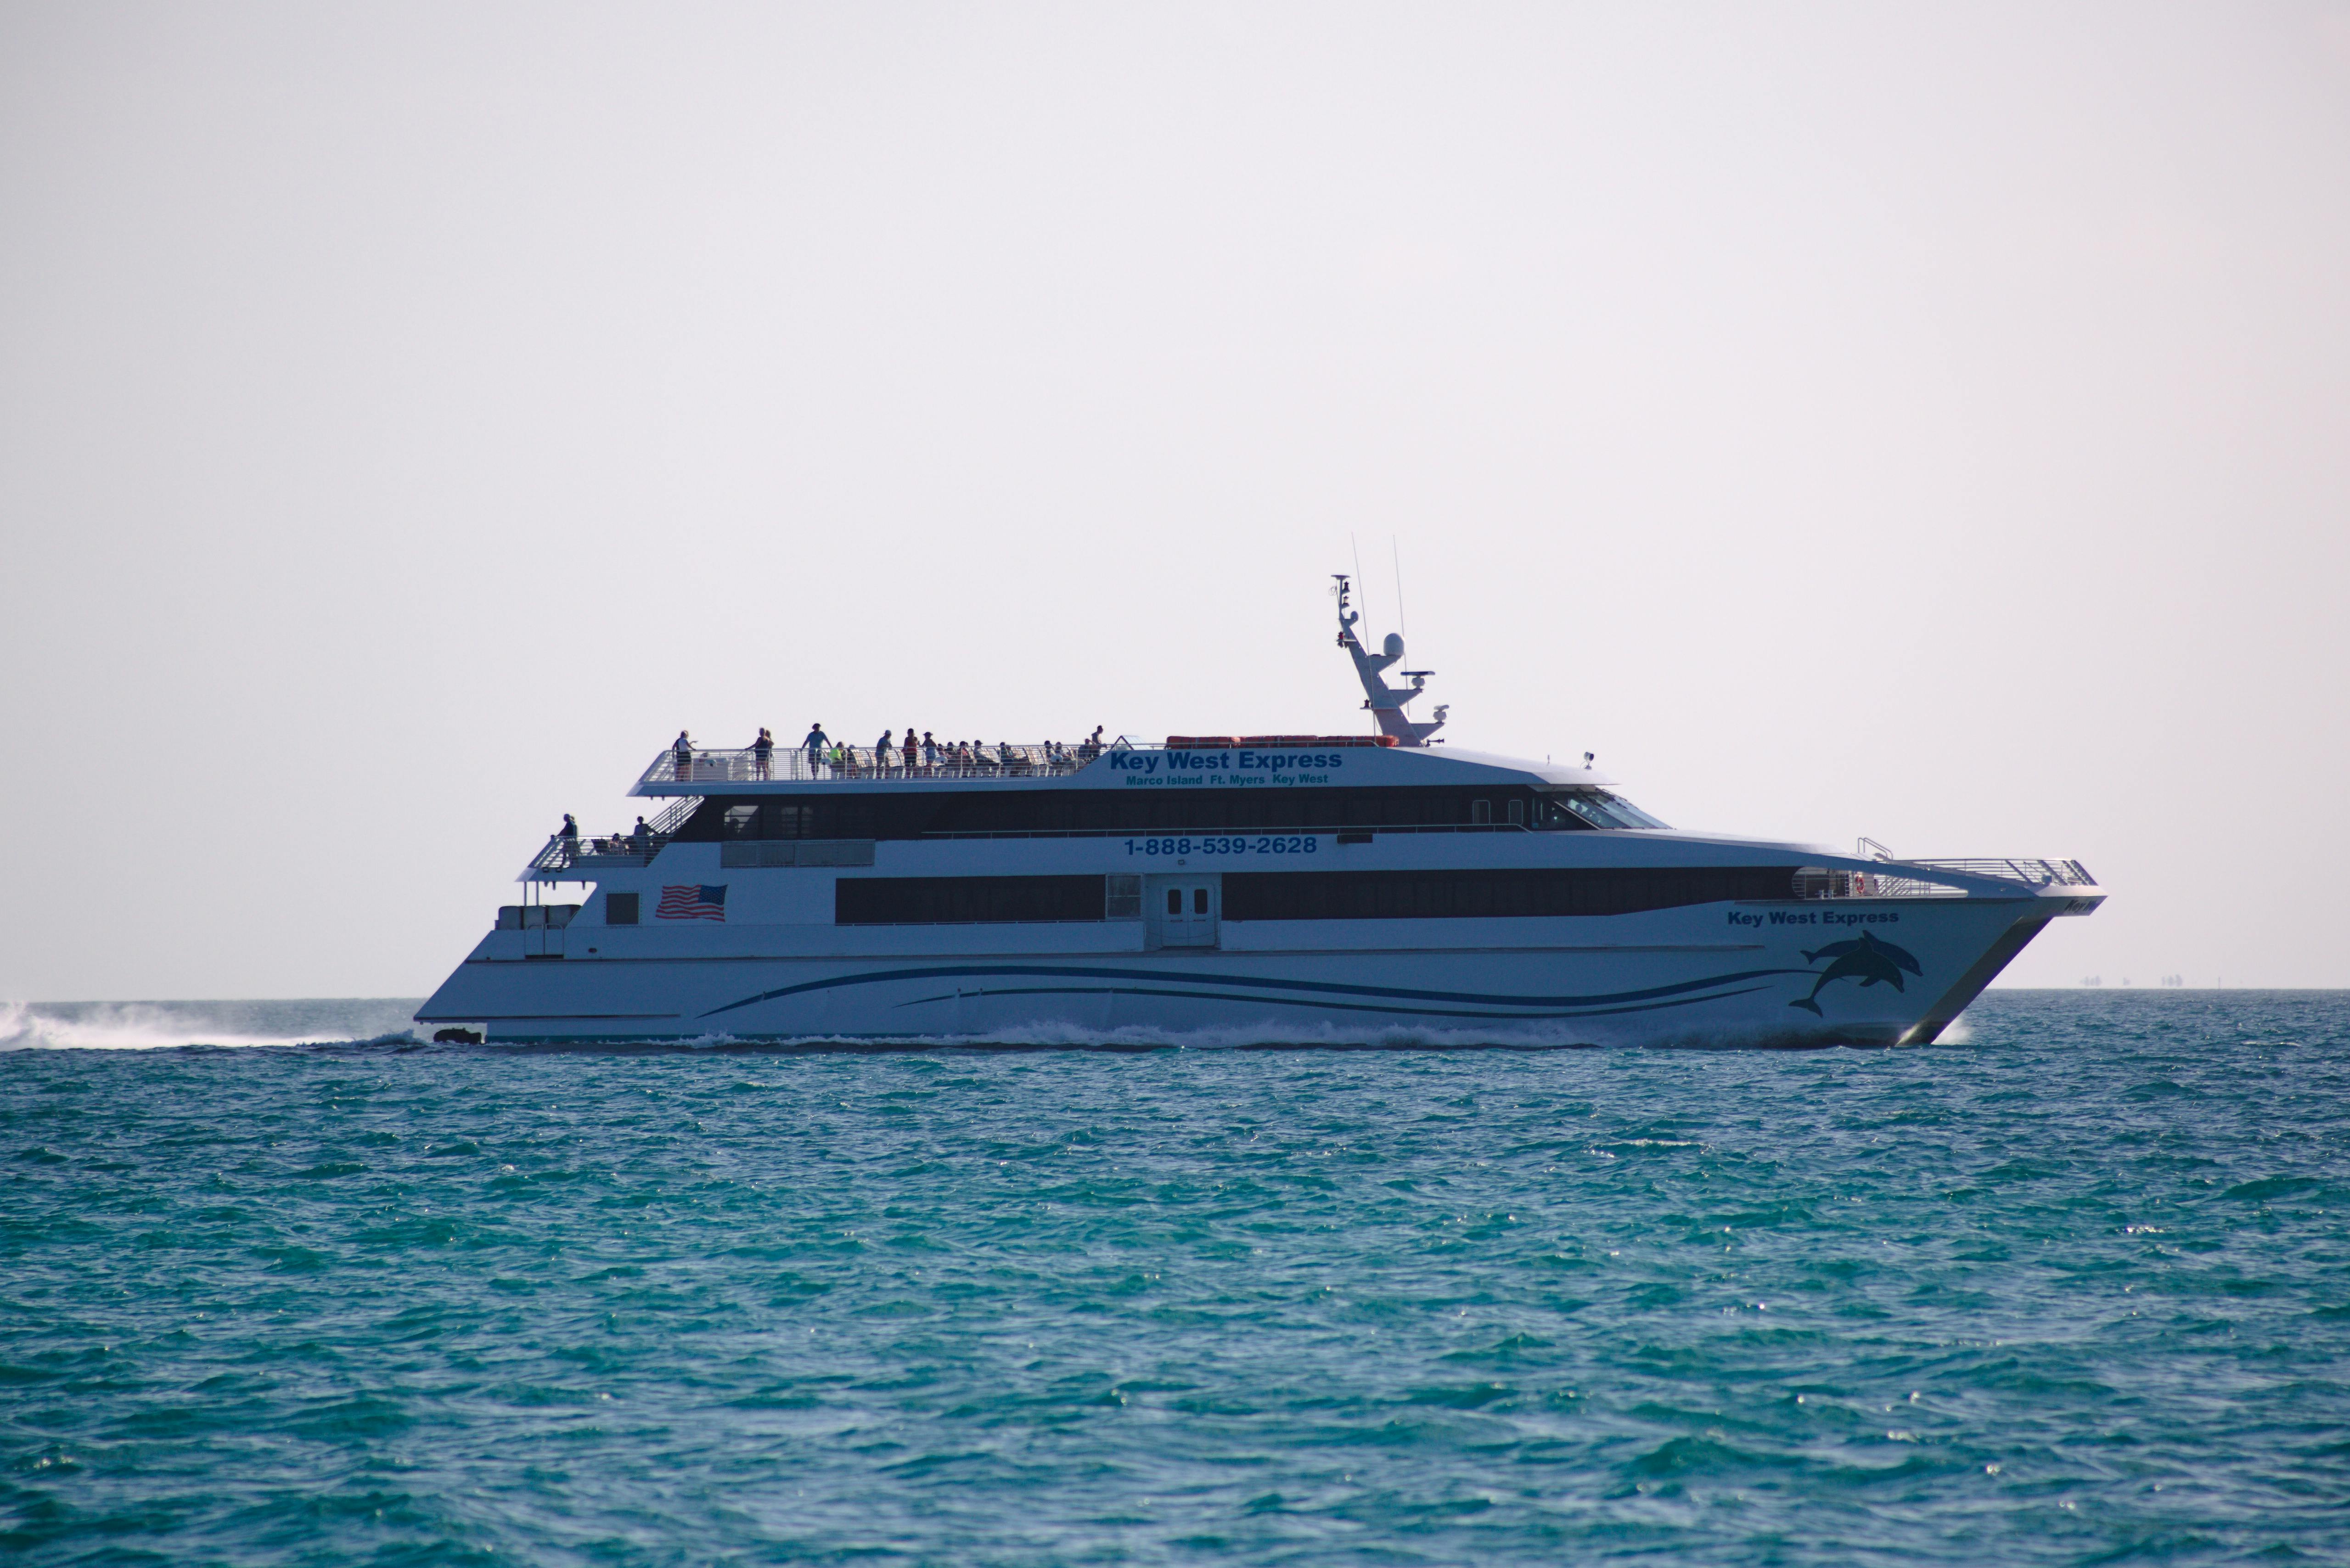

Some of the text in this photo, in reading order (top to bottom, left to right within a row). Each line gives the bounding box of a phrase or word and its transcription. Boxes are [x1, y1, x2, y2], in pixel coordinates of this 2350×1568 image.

[1110, 751, 1342, 774] Key West Express
[1126, 773, 1328, 786] Marco Island Ft. Myers Key West
[1124, 837, 1317, 855] 1-888-539-2628
[1728, 911, 1899, 927] Key West Express
